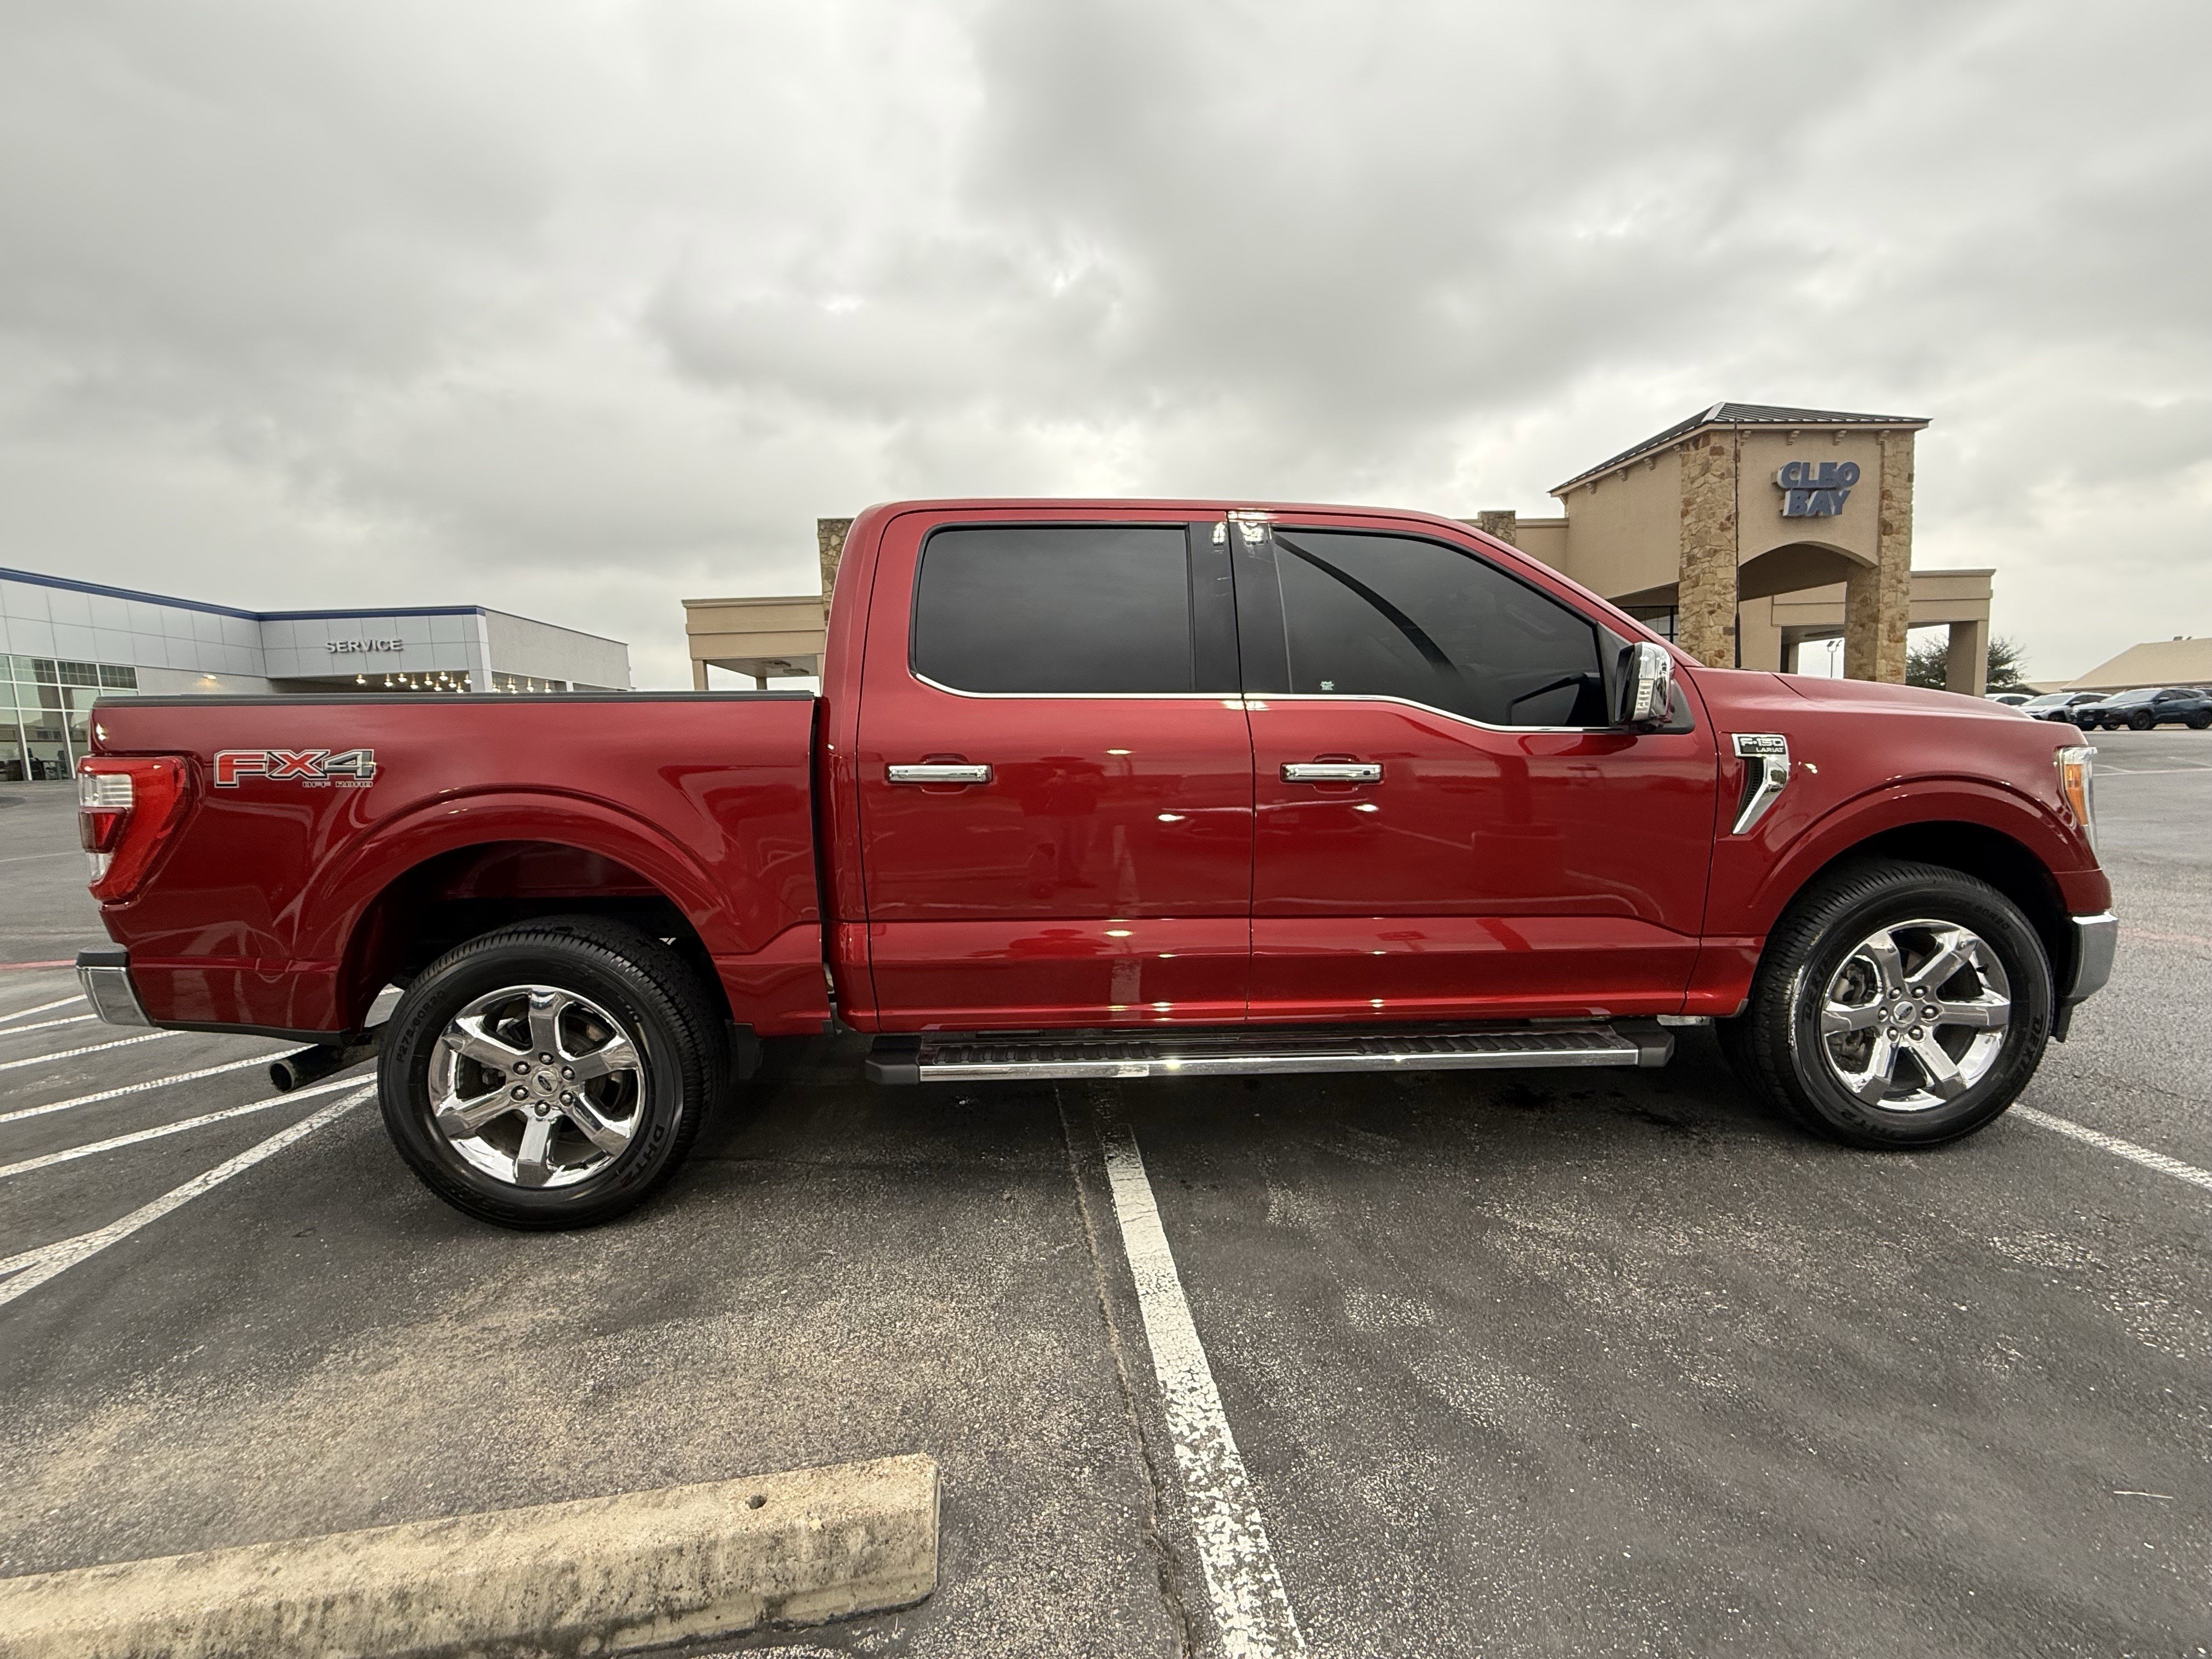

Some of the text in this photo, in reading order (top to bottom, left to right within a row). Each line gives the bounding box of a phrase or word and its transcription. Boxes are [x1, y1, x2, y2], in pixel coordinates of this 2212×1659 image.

[1778, 461, 1860, 488] CLEO
[1783, 489, 1851, 516] BAY
[325, 640, 403, 653] SERVICE
[215, 749, 376, 788] FX4
